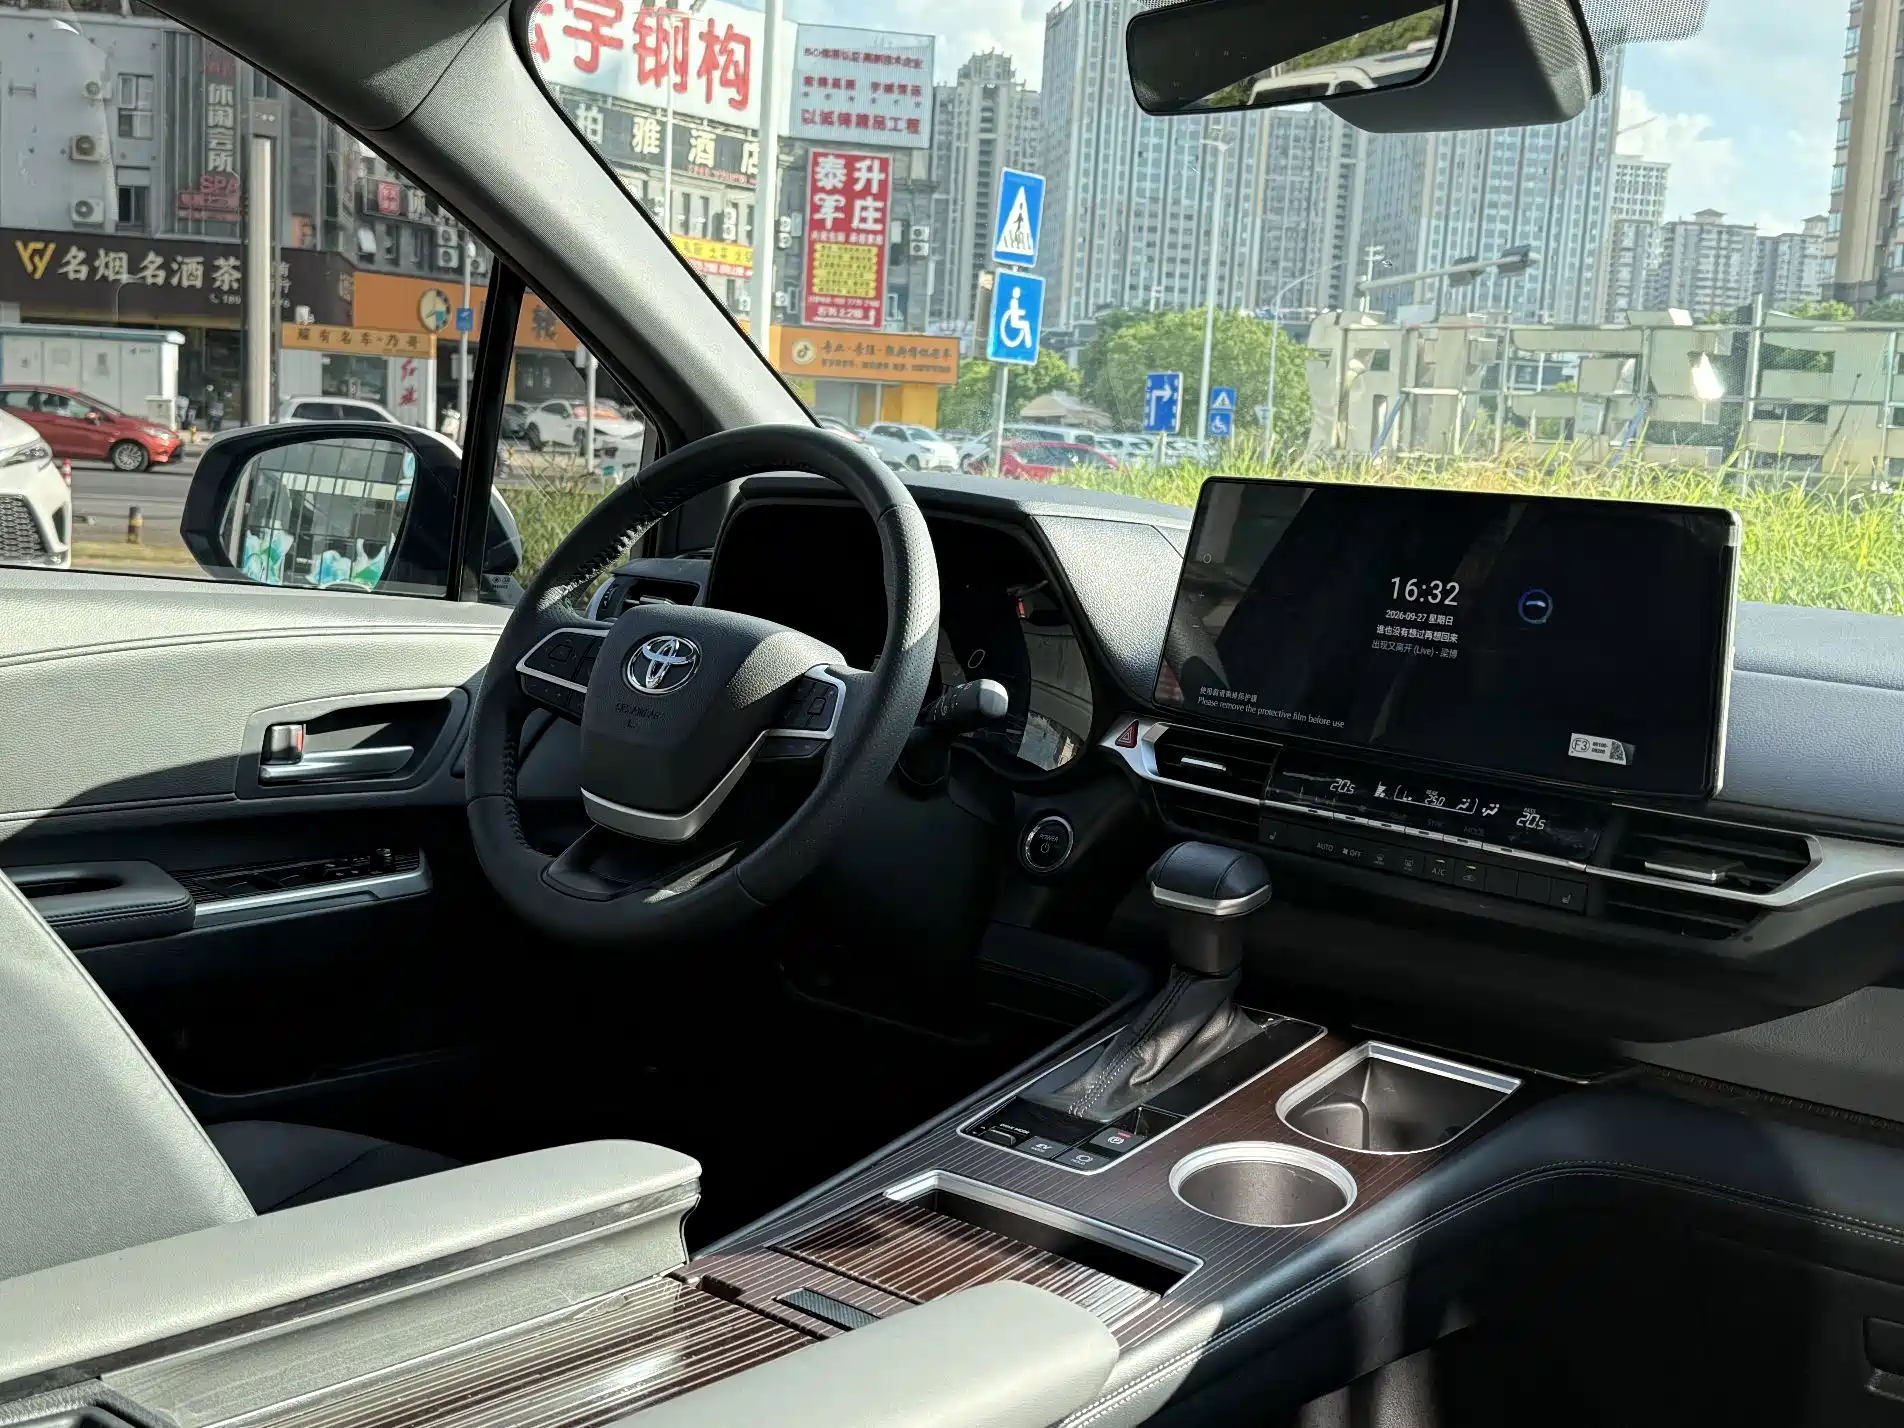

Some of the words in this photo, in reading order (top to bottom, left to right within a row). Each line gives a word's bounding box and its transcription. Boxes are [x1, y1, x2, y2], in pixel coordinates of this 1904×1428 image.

[57, 245, 242, 291] 名烟名酒茶
[1391, 576, 1460, 606] 16:32
[1385, 609, 1427, 622] 2026-09-27
[1428, 613, 1454, 626] 星期日
[1376, 624, 1459, 644] 谁也没有想过再想回来
[1413, 645, 1434, 657] (Live)
[1198, 696, 1218, 707] Please
[1219, 700, 1245, 711] remove
[1245, 703, 1257, 714] the
[1257, 708, 1292, 720] protective
[1292, 711, 1307, 722] film
[1308, 713, 1331, 726] before
[1332, 720, 1345, 728] use
[1316, 841, 1334, 852] AUTO
[1430, 866, 1447, 877] A/C
